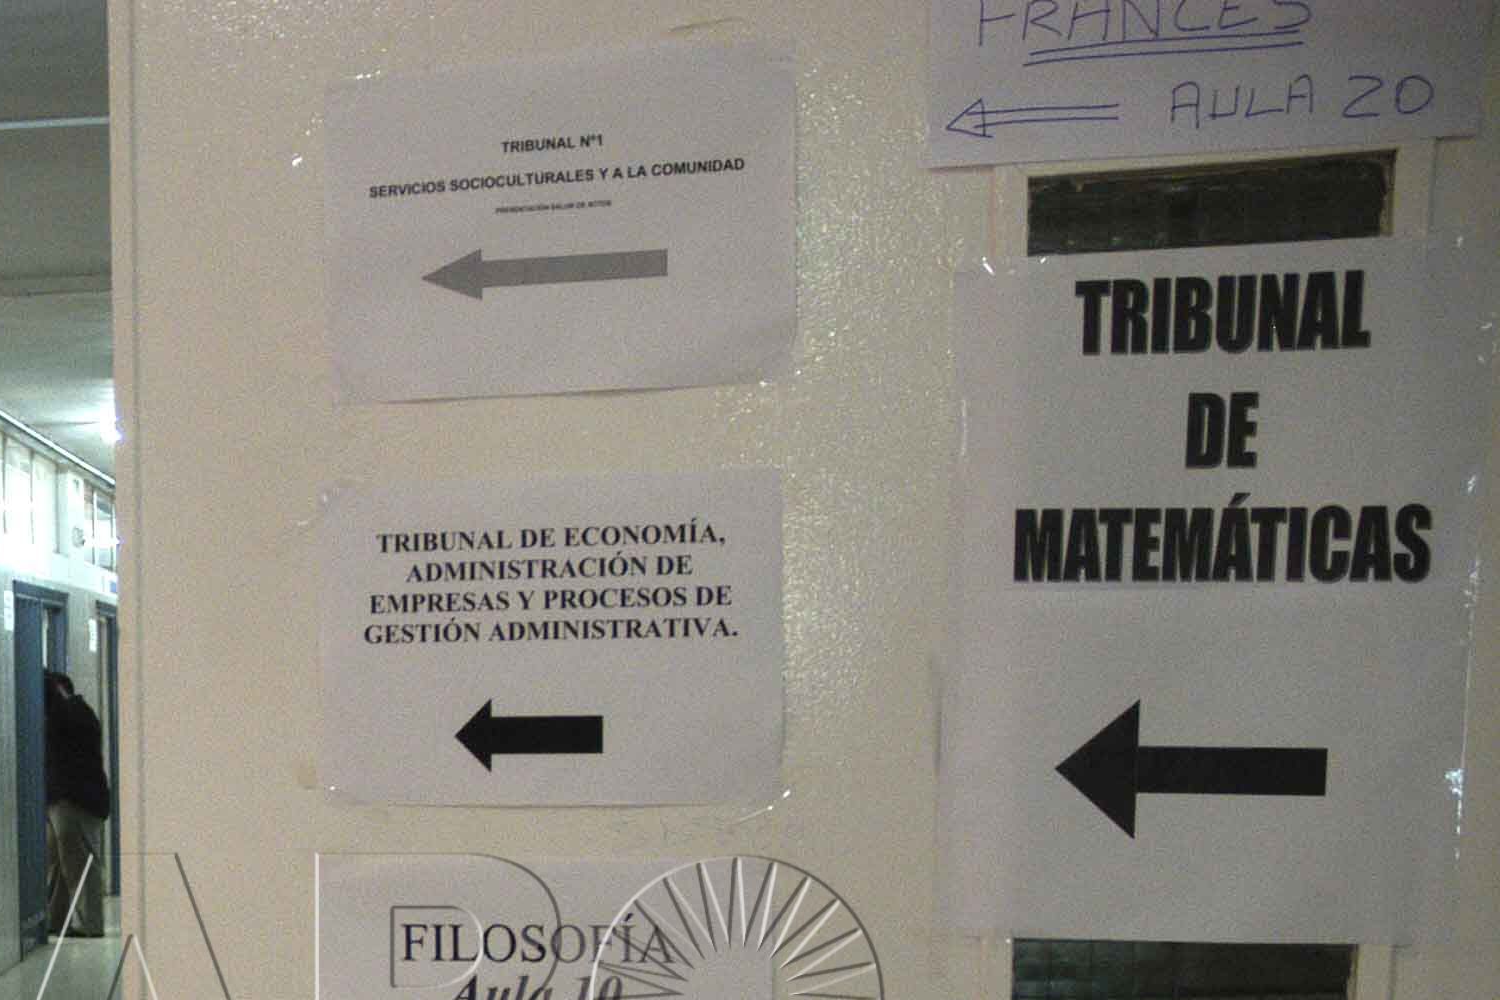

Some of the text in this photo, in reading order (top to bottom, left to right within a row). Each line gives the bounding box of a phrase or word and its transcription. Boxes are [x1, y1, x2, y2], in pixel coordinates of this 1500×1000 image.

[1171, 74, 1435, 128] AULA 20
[502, 137, 575, 154] TRIBUNAL
[368, 157, 745, 199] SERVICIOS SOCIOCULTURALES Y A LA COMUNIDAD
[1074, 270, 1372, 356] TRIBUNAL
[1185, 392, 1260, 469] DE
[376, 518, 726, 554] TRIBUNAL DE ECONOMÍA,
[1012, 493, 1433, 584] MATEMÁTICAS
[405, 550, 693, 582] ADMINISTRACIÓN DE
[369, 585, 732, 615] EMPRESAS Y PROCESOS DE
[364, 616, 739, 645] GESTIÓN ADMINISTRATIVA.
[402, 913, 676, 963] FILOSOFÍA
